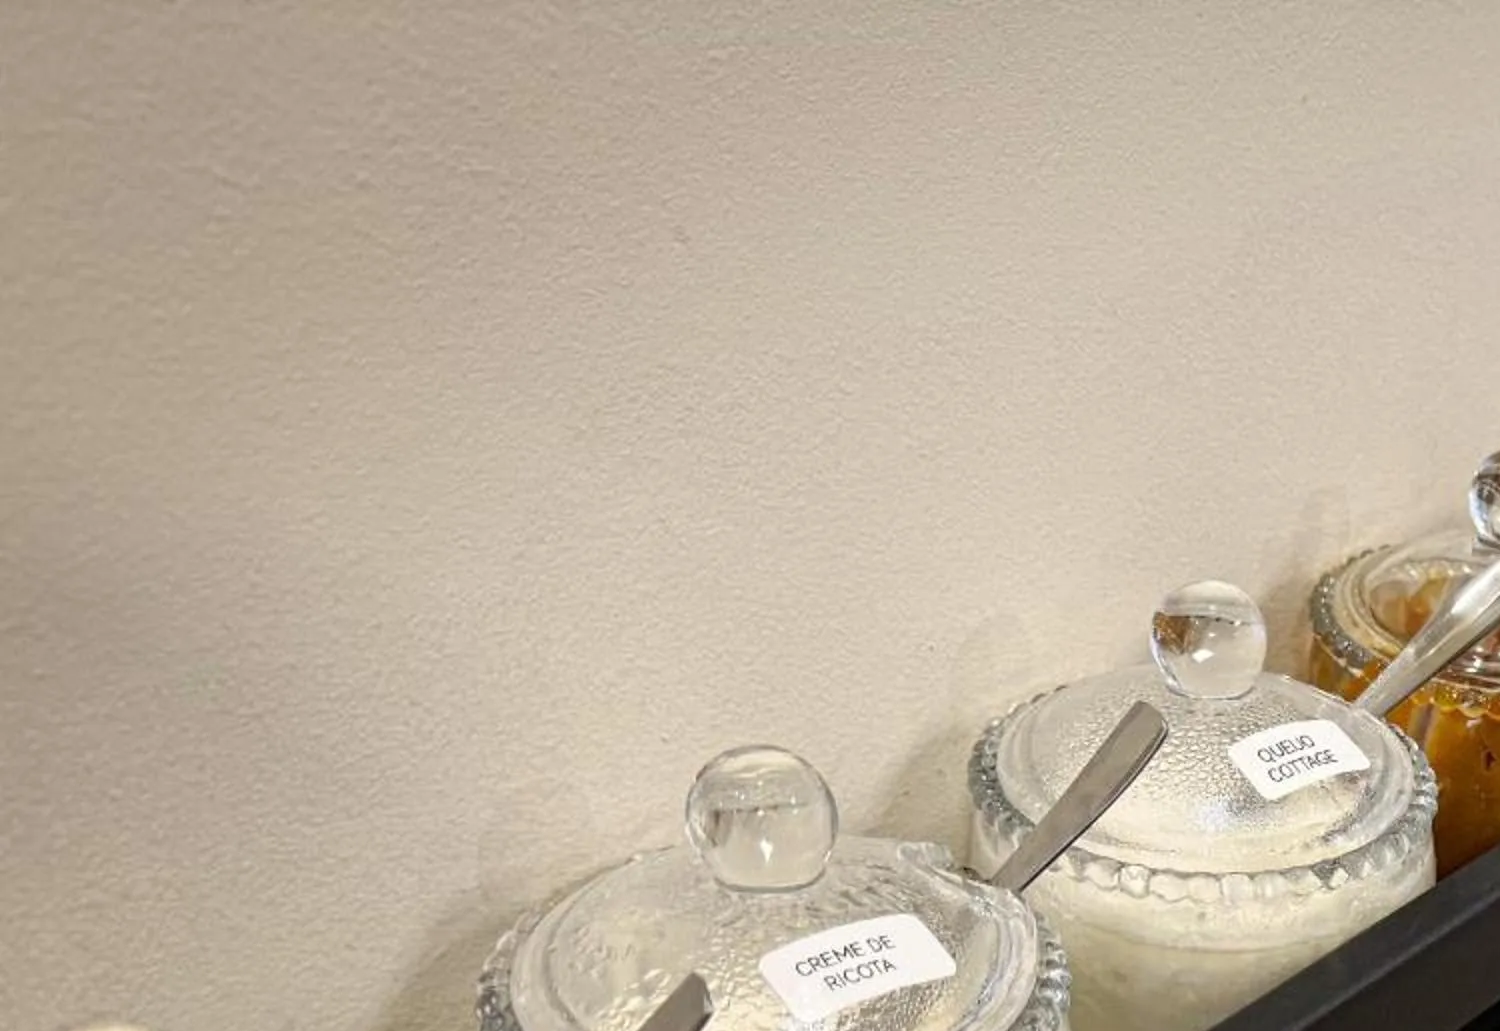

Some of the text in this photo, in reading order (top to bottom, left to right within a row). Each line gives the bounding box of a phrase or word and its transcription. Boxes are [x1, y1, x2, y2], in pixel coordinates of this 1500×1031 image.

[1257, 735, 1316, 763] QUEIJO
[1268, 749, 1339, 783] COTTAGE
[795, 934, 896, 977] CREME DE
[823, 959, 897, 992] RICOTA
